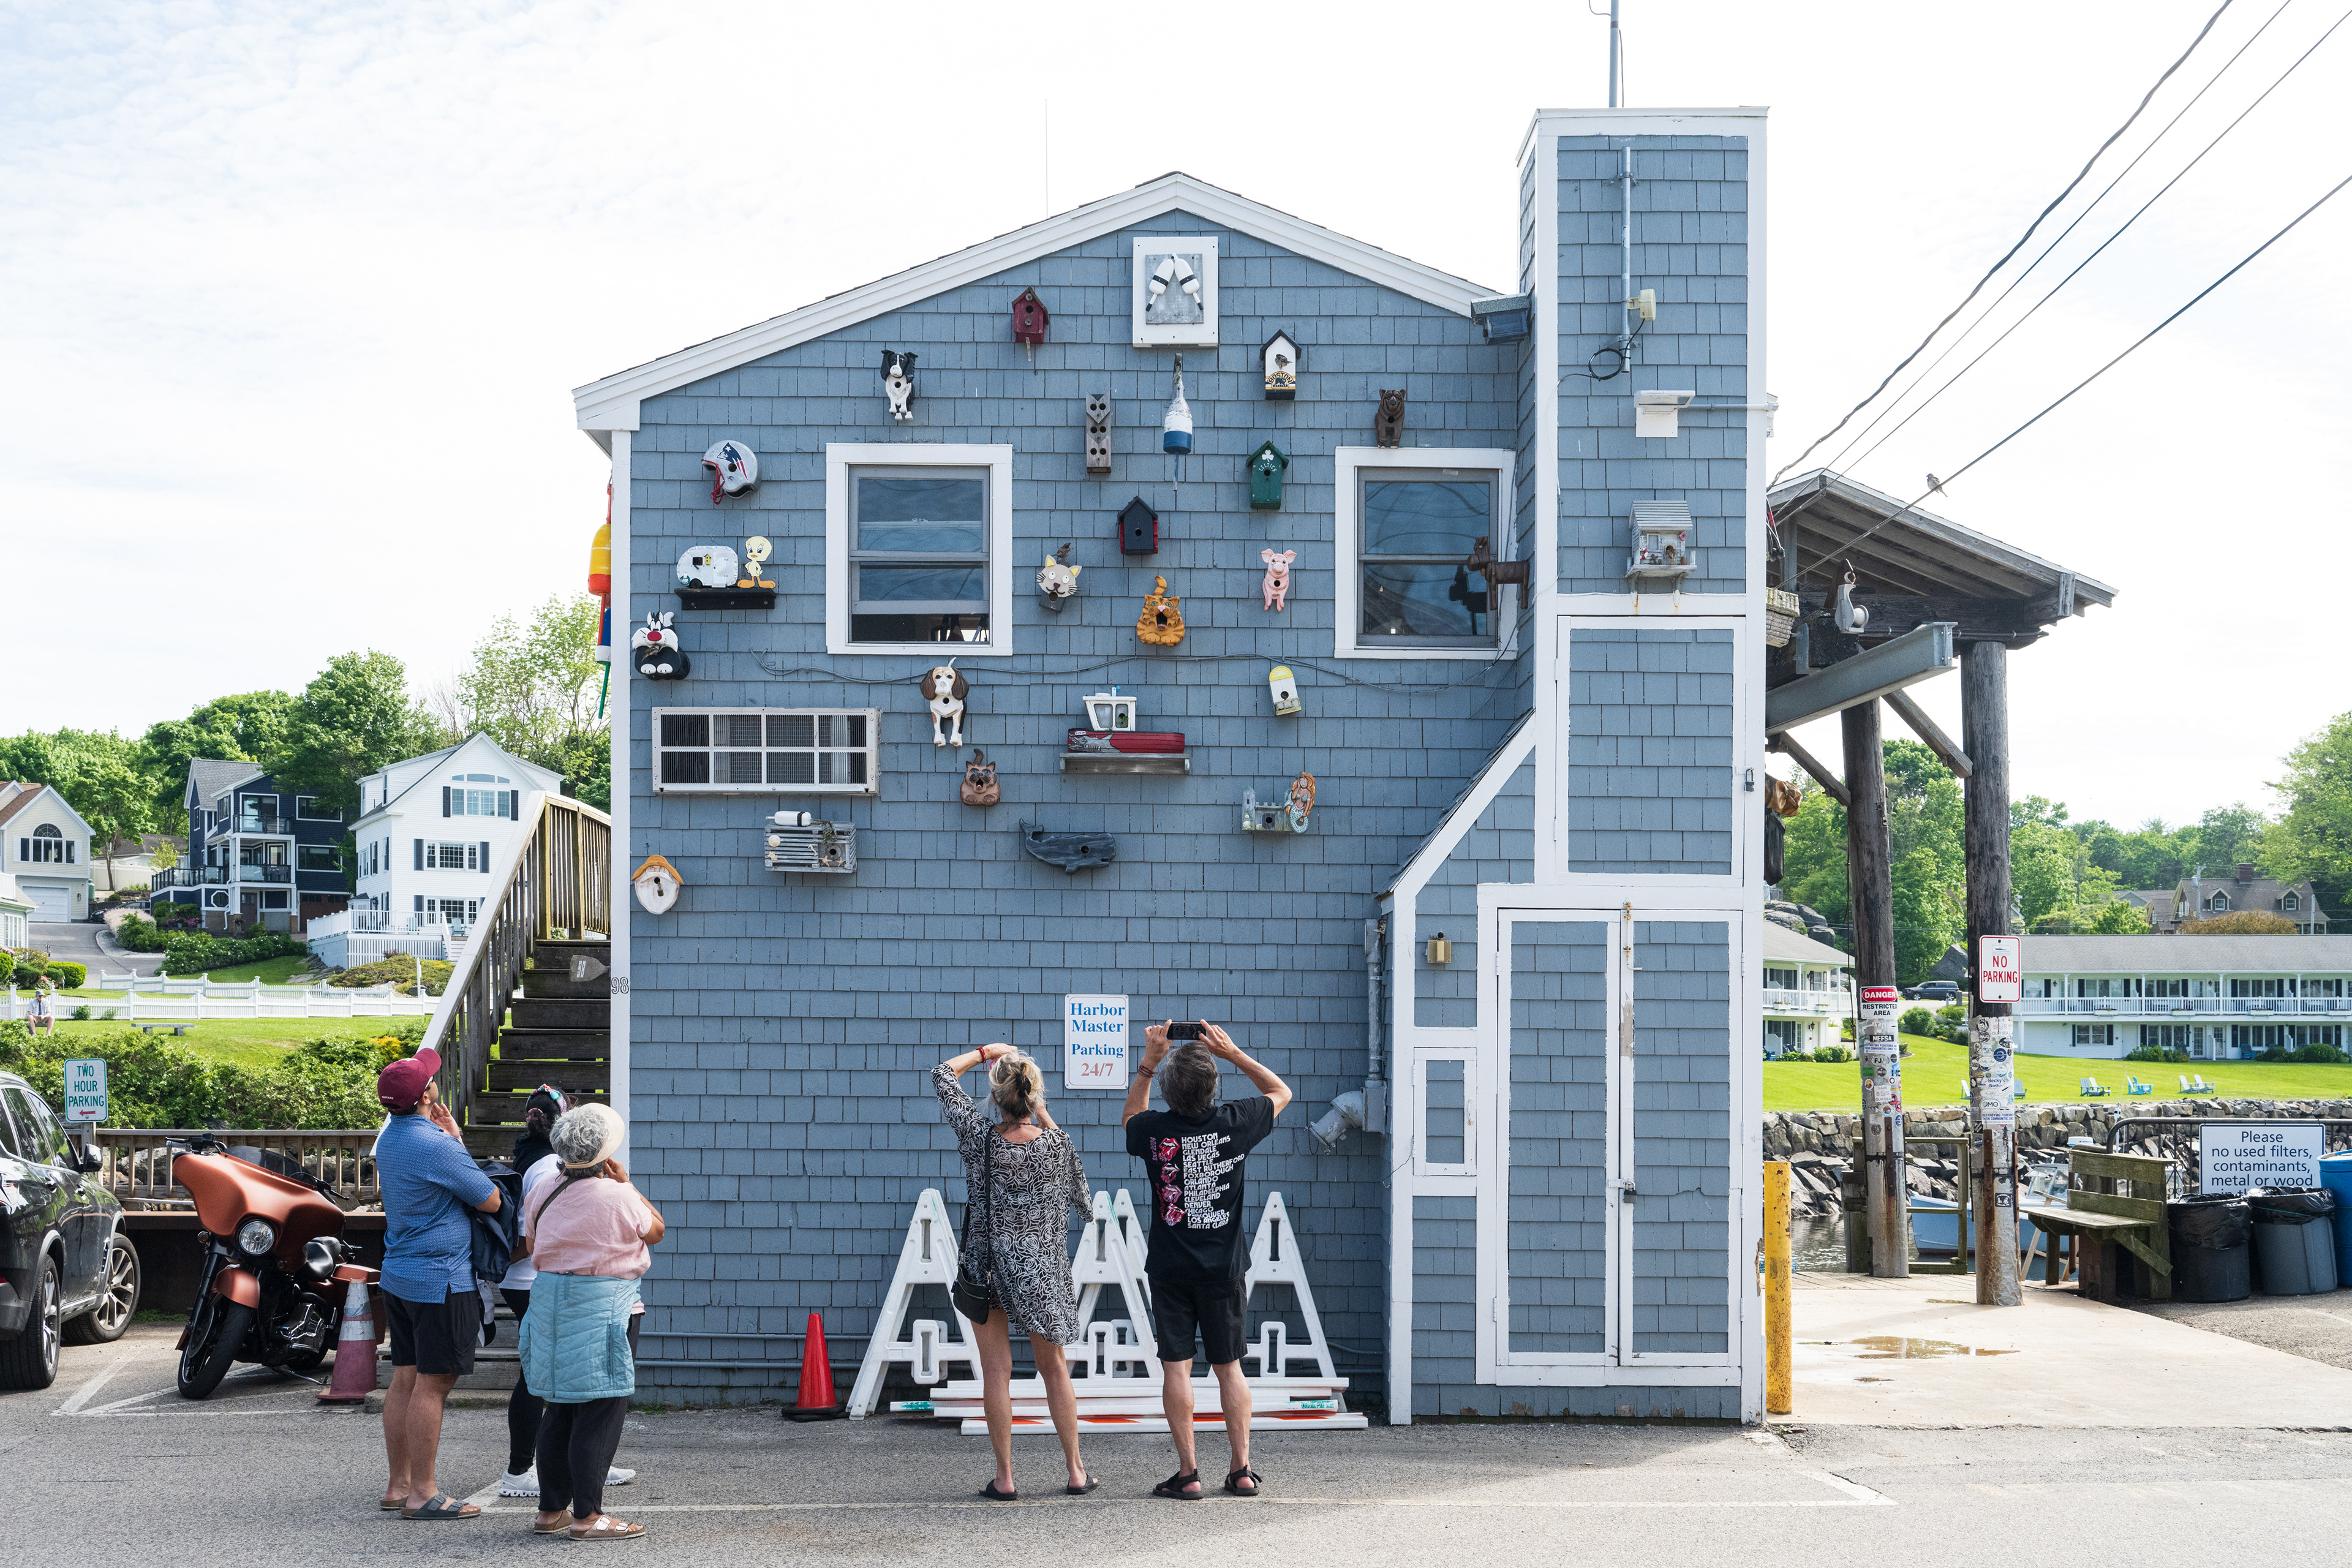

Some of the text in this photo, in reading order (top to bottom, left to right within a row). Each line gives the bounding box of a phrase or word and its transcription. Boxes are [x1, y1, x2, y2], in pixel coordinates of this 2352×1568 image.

[1268, 372, 1292, 383] BOSTON
[1259, 462, 1277, 472] CELTICS
[1992, 956, 2007, 968] NO
[576, 960, 586, 978] 98
[1983, 970, 2018, 984] PARKING
[611, 976, 630, 995] 98
[1070, 1003, 1125, 1016] Harbor
[1071, 1019, 1124, 1033] Master
[1071, 1043, 1124, 1058] Parking
[77, 1065, 94, 1077] TWO
[1080, 1063, 1114, 1077] 24/7
[74, 1080, 98, 1092] HOUR
[68, 1095, 104, 1107] PARKING
[1181, 1132, 1218, 1144] HOUSTON
[1200, 1135, 1231, 1148] ORLEANS
[2241, 1130, 2283, 1143] Please
[1182, 1145, 1217, 1155] GLENDALE
[1197, 1151, 1220, 1161] VEGAS
[2212, 1145, 2312, 1159] no used filters,
[1183, 1159, 1214, 1168] SEATTLE
[1204, 1153, 1245, 1172] RUTHERFORD
[2213, 1159, 2310, 1174] contaminants,
[1183, 1164, 1234, 1179] FOXBOROUGH
[1183, 1175, 1219, 1185] ORLANDO
[2211, 1174, 2313, 1186] metal or wood
[1184, 1182, 1216, 1191] ATLANTA
[1184, 1183, 1230, 1197] PHILADELPHIA
[1184, 1192, 1221, 1202] CLEVELAND
[1185, 1206, 1214, 1215] CHICAGO
[1187, 1209, 1225, 1218] COUVER
[1203, 1212, 1230, 1224] ANGELES
[1212, 1218, 1229, 1229] CLARA
